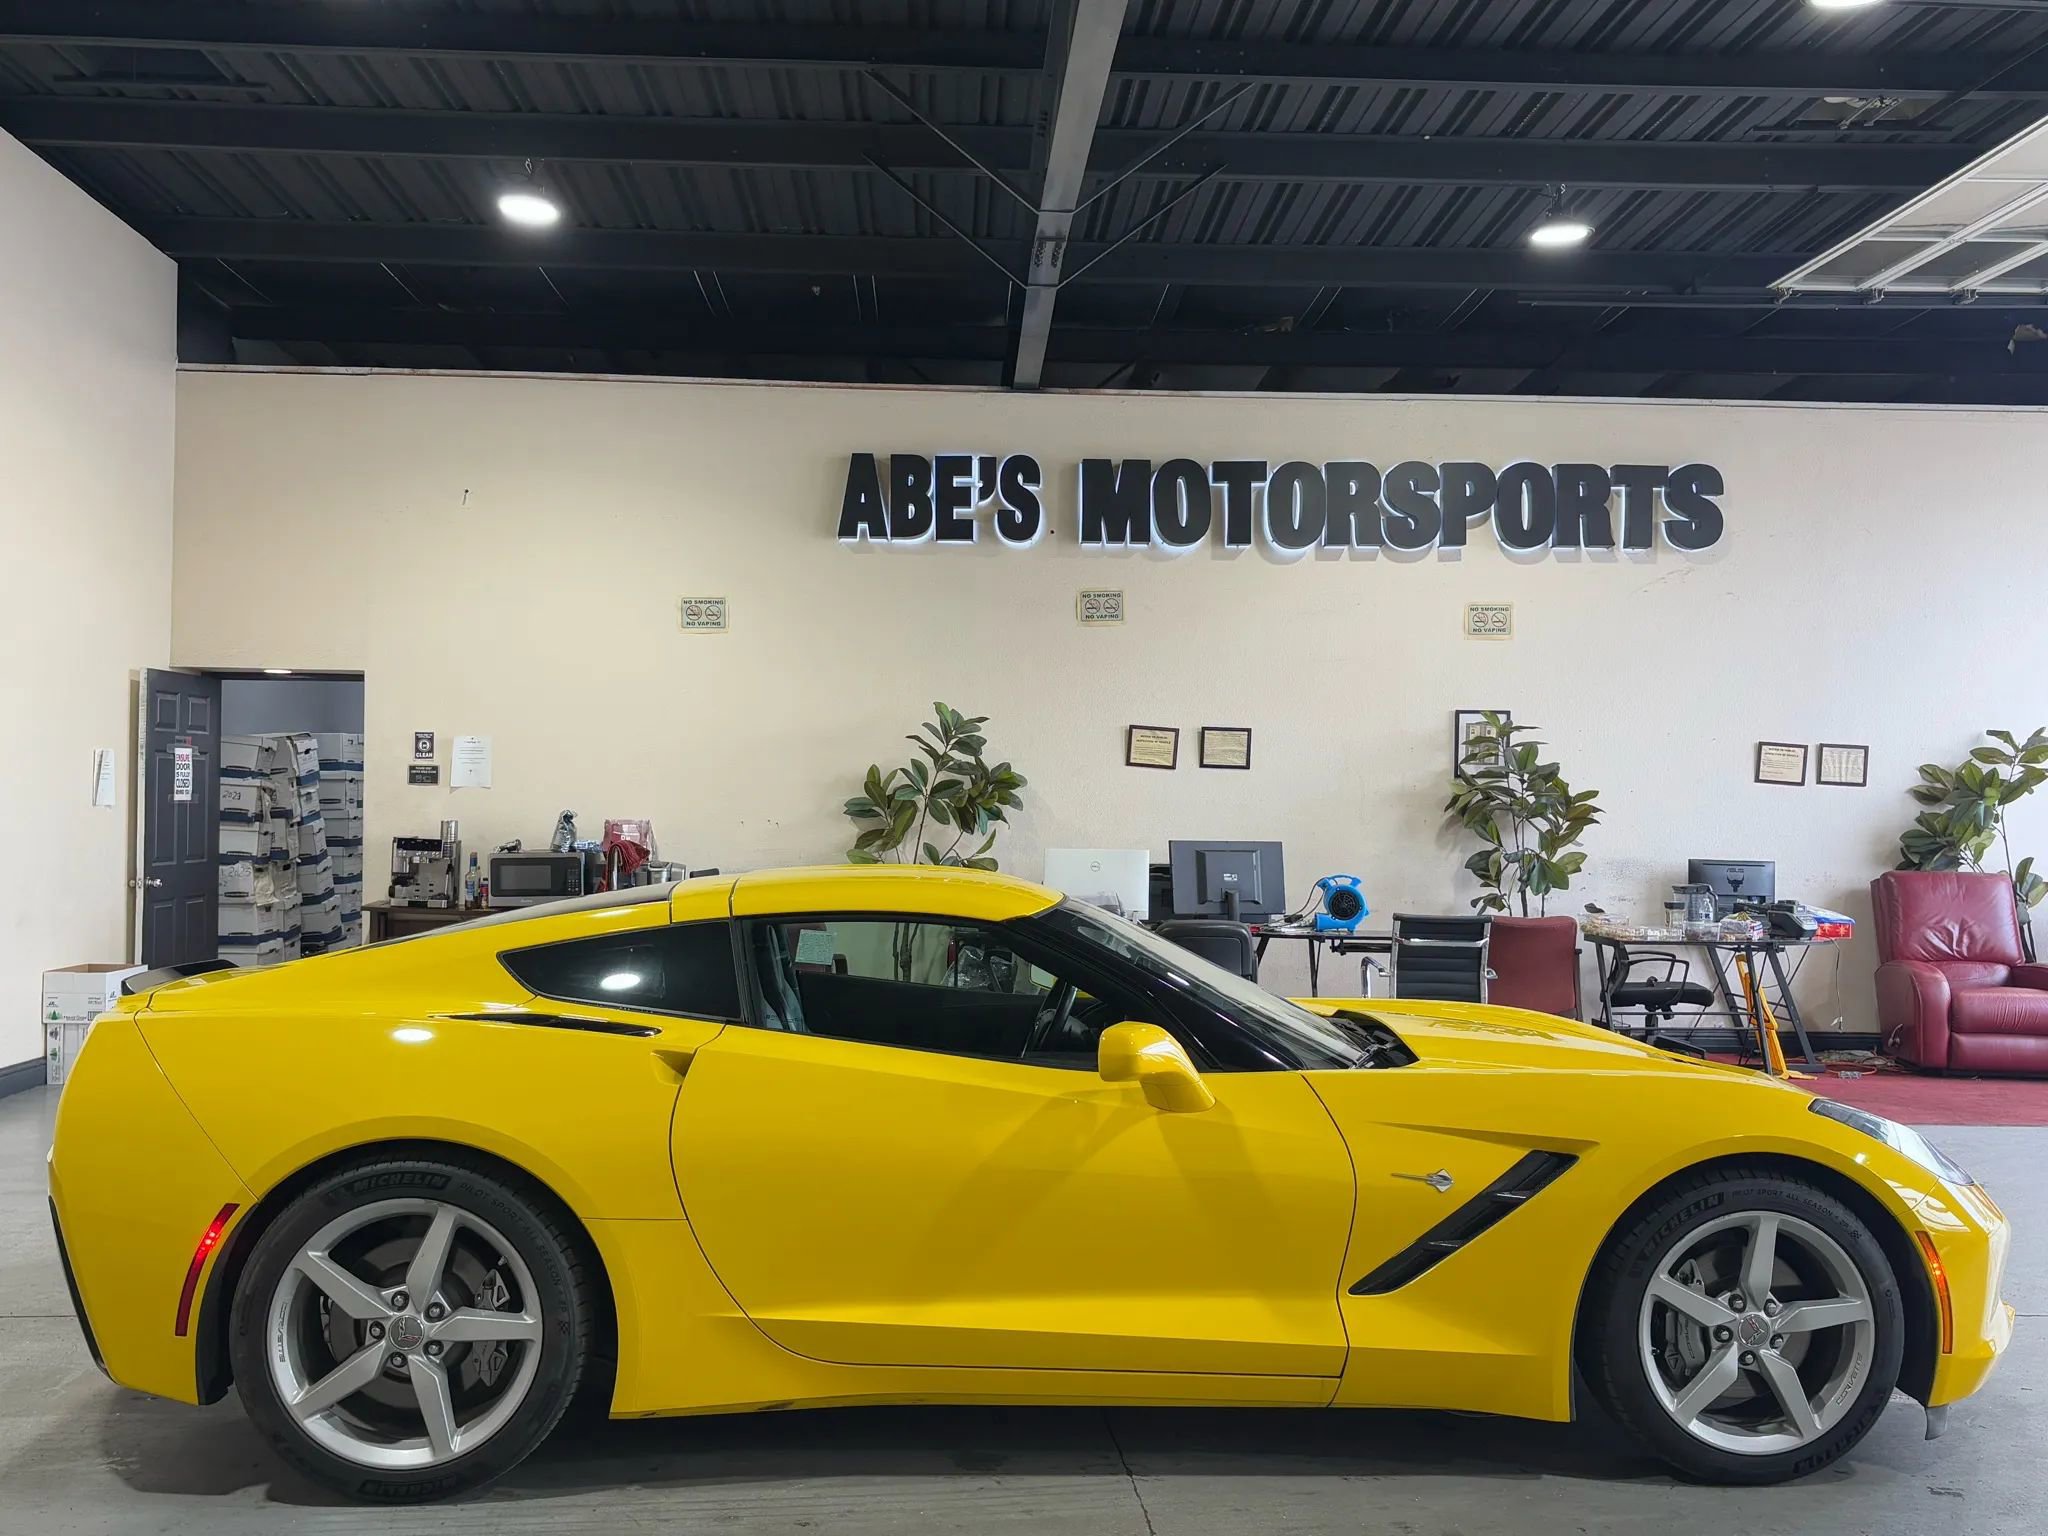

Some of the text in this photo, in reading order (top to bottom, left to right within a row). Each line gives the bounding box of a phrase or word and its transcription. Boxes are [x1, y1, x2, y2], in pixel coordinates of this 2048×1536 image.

[838, 453, 1724, 551] ABE'S MOTORSPORTS
[175, 762, 191, 771] DOOR
[222, 790, 241, 801] 2023
[352, 1171, 448, 1194] MICHELIN
[459, 1182, 489, 1201] PILOT
[491, 1198, 524, 1225] SPORT
[1642, 1191, 1721, 1258] MICHELIN
[1756, 1187, 1784, 1198] SPORT
[1785, 1192, 1801, 1202] ALL
[1802, 1198, 1834, 1218] SEASON
[276, 1301, 289, 1363] CORVETTE
[1836, 1351, 1864, 1406] CORVETTE
